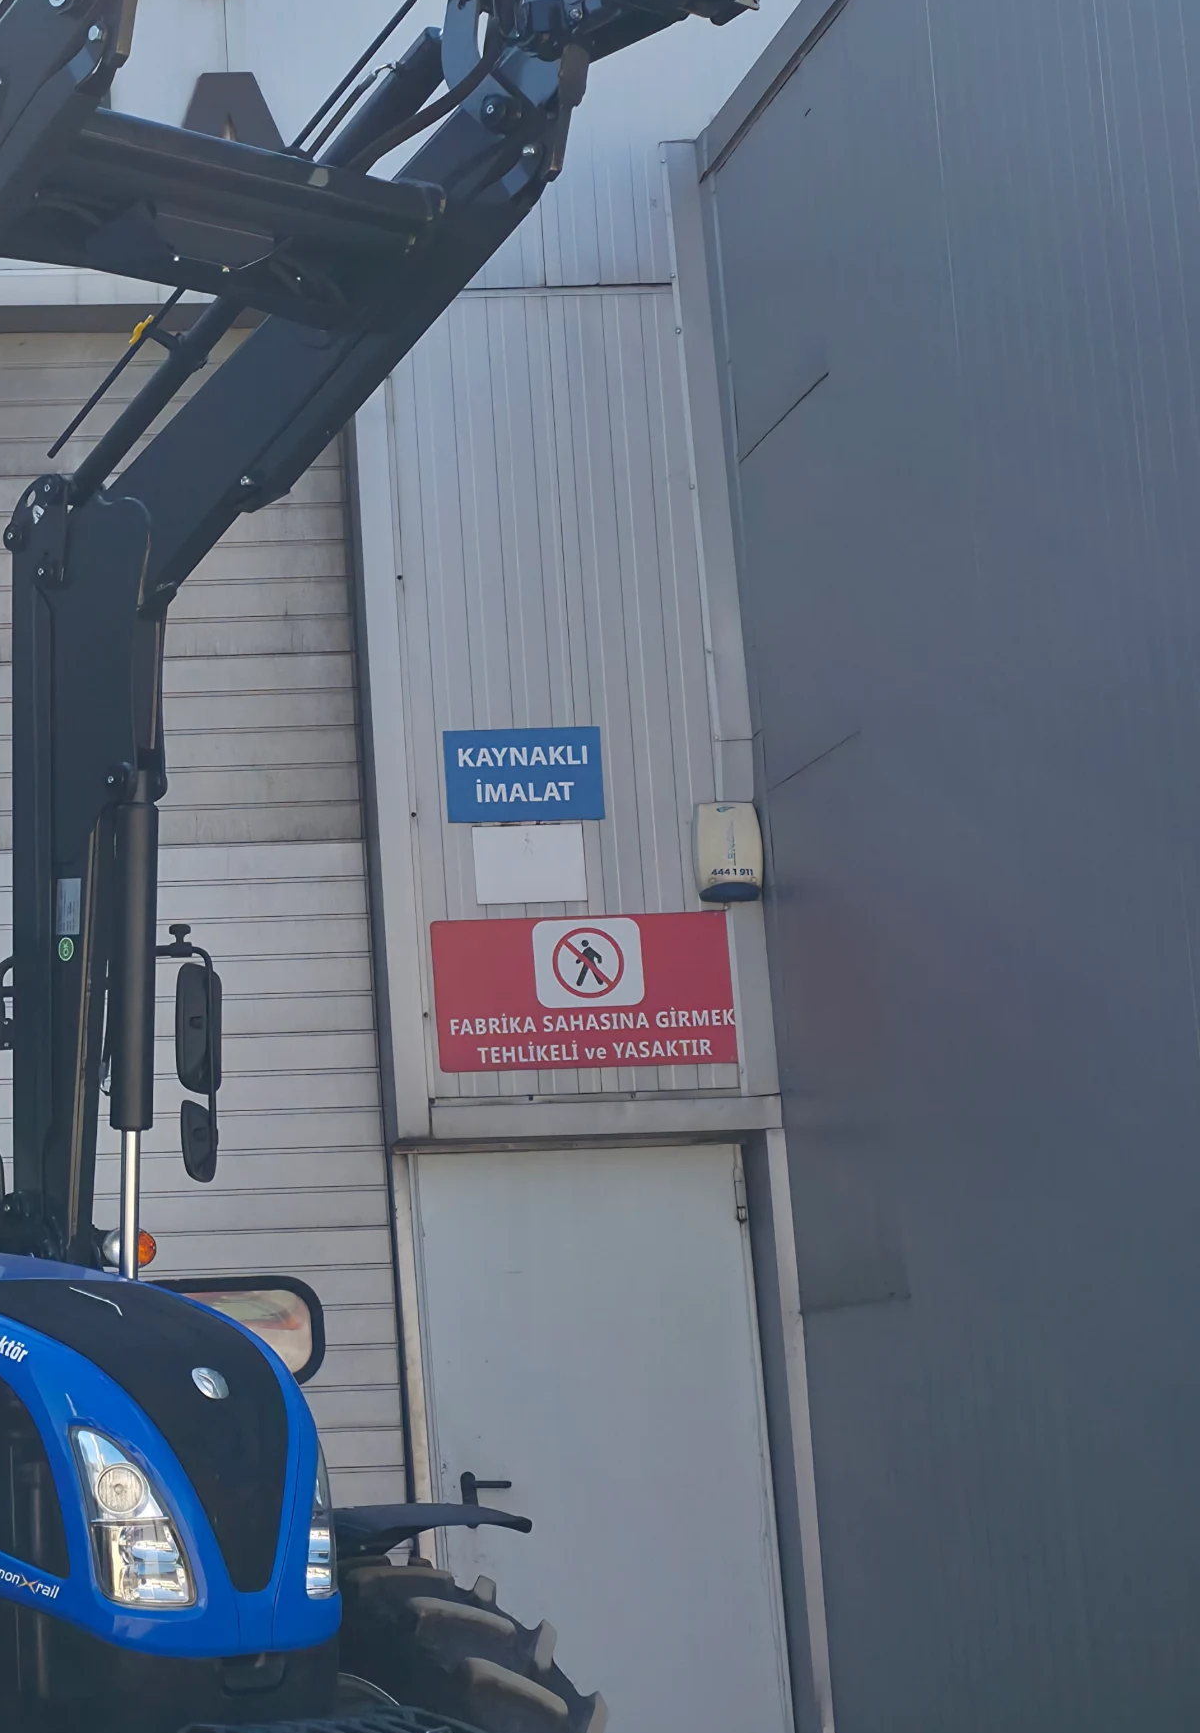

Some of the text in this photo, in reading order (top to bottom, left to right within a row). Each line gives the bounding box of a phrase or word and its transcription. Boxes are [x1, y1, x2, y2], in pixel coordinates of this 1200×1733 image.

[457, 745, 588, 768] KAYNAKLI
[476, 779, 574, 803] İMALAT
[711, 868, 731, 876] 444
[732, 868, 737, 876] 1
[450, 1007, 736, 1036] FABRİKA SAHASINA GİRMEK
[477, 1039, 712, 1064] TEHLİKELİ ve YASAKTIR
